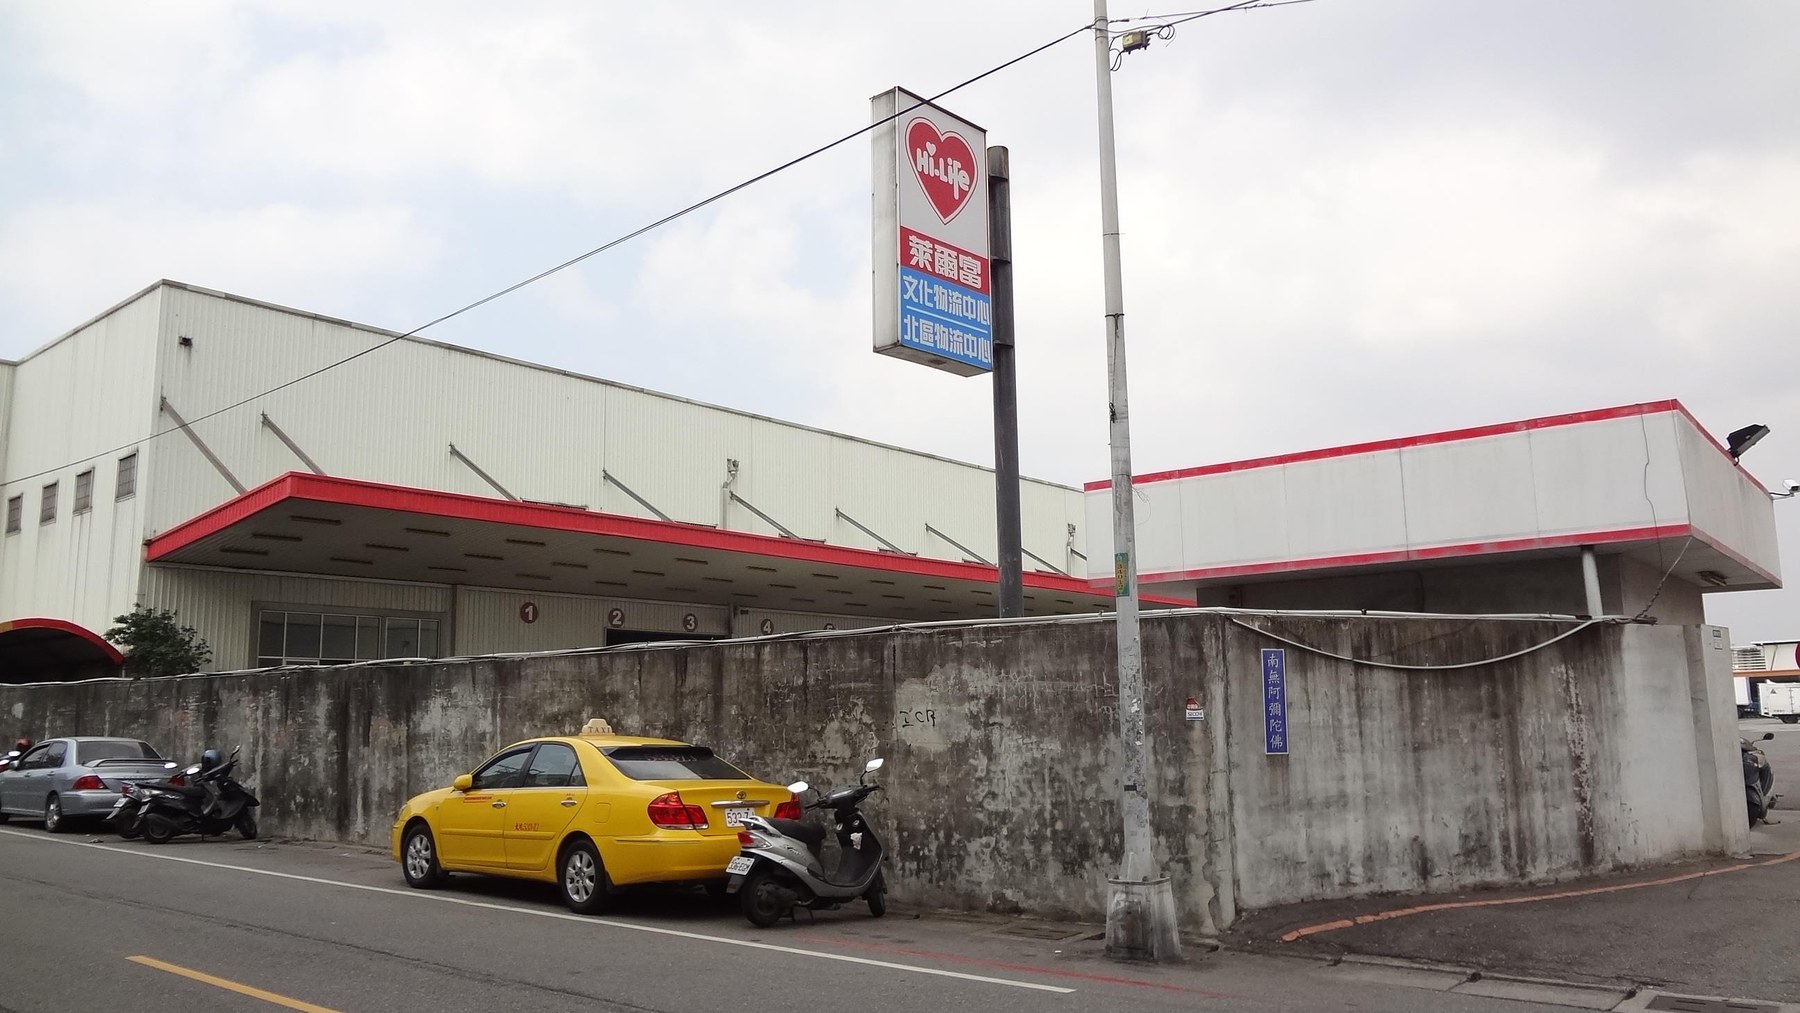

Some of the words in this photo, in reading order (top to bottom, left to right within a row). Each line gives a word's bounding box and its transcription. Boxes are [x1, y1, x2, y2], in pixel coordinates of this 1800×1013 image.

[908, 234, 982, 289] 萊爾富
[902, 274, 991, 326] 文化物流中心
[903, 313, 992, 364] 北區物流中心
[524, 605, 535, 621] 1
[611, 610, 622, 625] 2
[686, 615, 696, 630] 3
[762, 620, 772, 634] 4
[1267, 653, 1283, 750] 南無阿彌陀佛
[588, 726, 611, 734] TAXI
